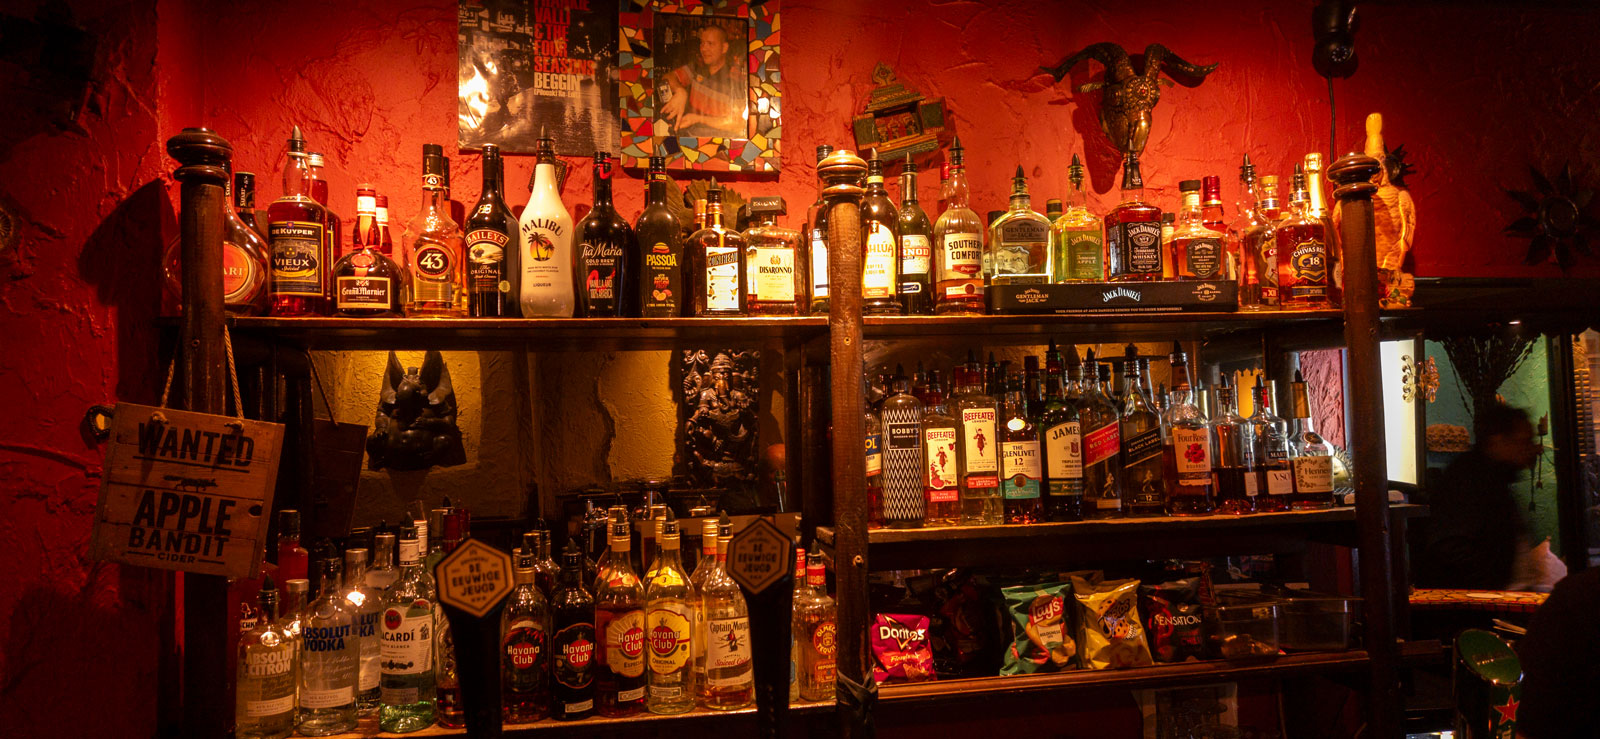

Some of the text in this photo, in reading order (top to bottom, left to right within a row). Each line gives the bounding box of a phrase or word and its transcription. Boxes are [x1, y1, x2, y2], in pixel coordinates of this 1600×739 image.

[534, 23, 568, 42] & THE
[534, 39, 568, 58] FOUR
[534, 56, 595, 76] SEASONS
[522, 218, 564, 237] MALIBU
[1128, 224, 1160, 238] JACK DANIEL'S
[466, 231, 506, 244] BAILEYS
[1070, 236, 1083, 246] JACK
[579, 242, 623, 258] Tia Maria
[1293, 247, 1316, 258] CHIVAS
[420, 253, 444, 270] 43
[1309, 256, 1320, 265] 18
[759, 266, 793, 274] DISARONNO
[359, 286, 386, 296] Marnier
[1103, 287, 1141, 303] JACK DANIEL'S
[964, 412, 994, 422] BEEFEATER
[891, 427, 919, 435] BOBBY'S
[927, 431, 954, 440] BEEFEATER
[1178, 434, 1192, 442] Four
[138, 422, 254, 467] WANTED
[1089, 440, 1102, 449] RED
[1128, 444, 1144, 452] BLACK
[1144, 438, 1160, 446] LABEL
[1002, 450, 1035, 458] GLENLIVET
[1014, 458, 1024, 466] 12
[1146, 494, 1152, 502] 12
[133, 490, 237, 536] APPLE
[128, 527, 229, 557] BANDIT
[157, 552, 195, 563] CIDER
[469, 563, 480, 573] DE
[452, 571, 500, 587] EEUWIGE
[461, 583, 495, 596] JEUGD
[1032, 599, 1061, 623] Lay's
[301, 624, 351, 639] ABSOLUT
[710, 622, 732, 634] Captain
[816, 624, 836, 637] OLMEC
[879, 626, 926, 641] Doritos
[618, 631, 644, 643] Havan
[303, 638, 345, 652] VODKA
[507, 645, 540, 655] Havana
[562, 642, 594, 654] Havana
[625, 641, 643, 652] Club
[653, 639, 672, 649] Club
[246, 647, 294, 665] ABSOLUT
[513, 655, 533, 665] Club
[570, 653, 589, 664] Club
[249, 660, 291, 676] CITRON
